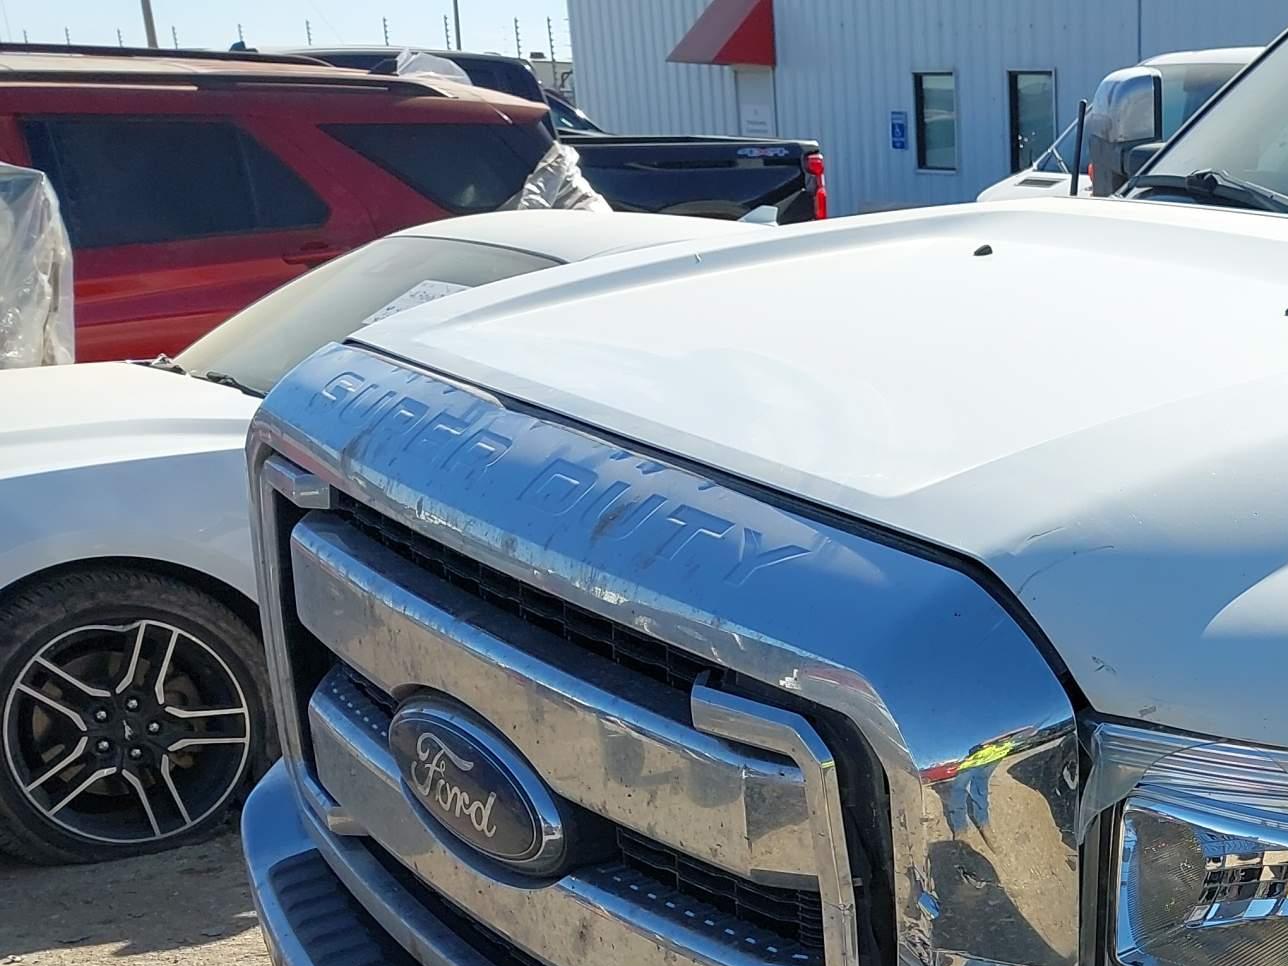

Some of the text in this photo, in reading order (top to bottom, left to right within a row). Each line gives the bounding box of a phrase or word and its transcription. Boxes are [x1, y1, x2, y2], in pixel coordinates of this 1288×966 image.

[307, 370, 812, 586] SUPER DUTY
[410, 732, 497, 838] Ford
